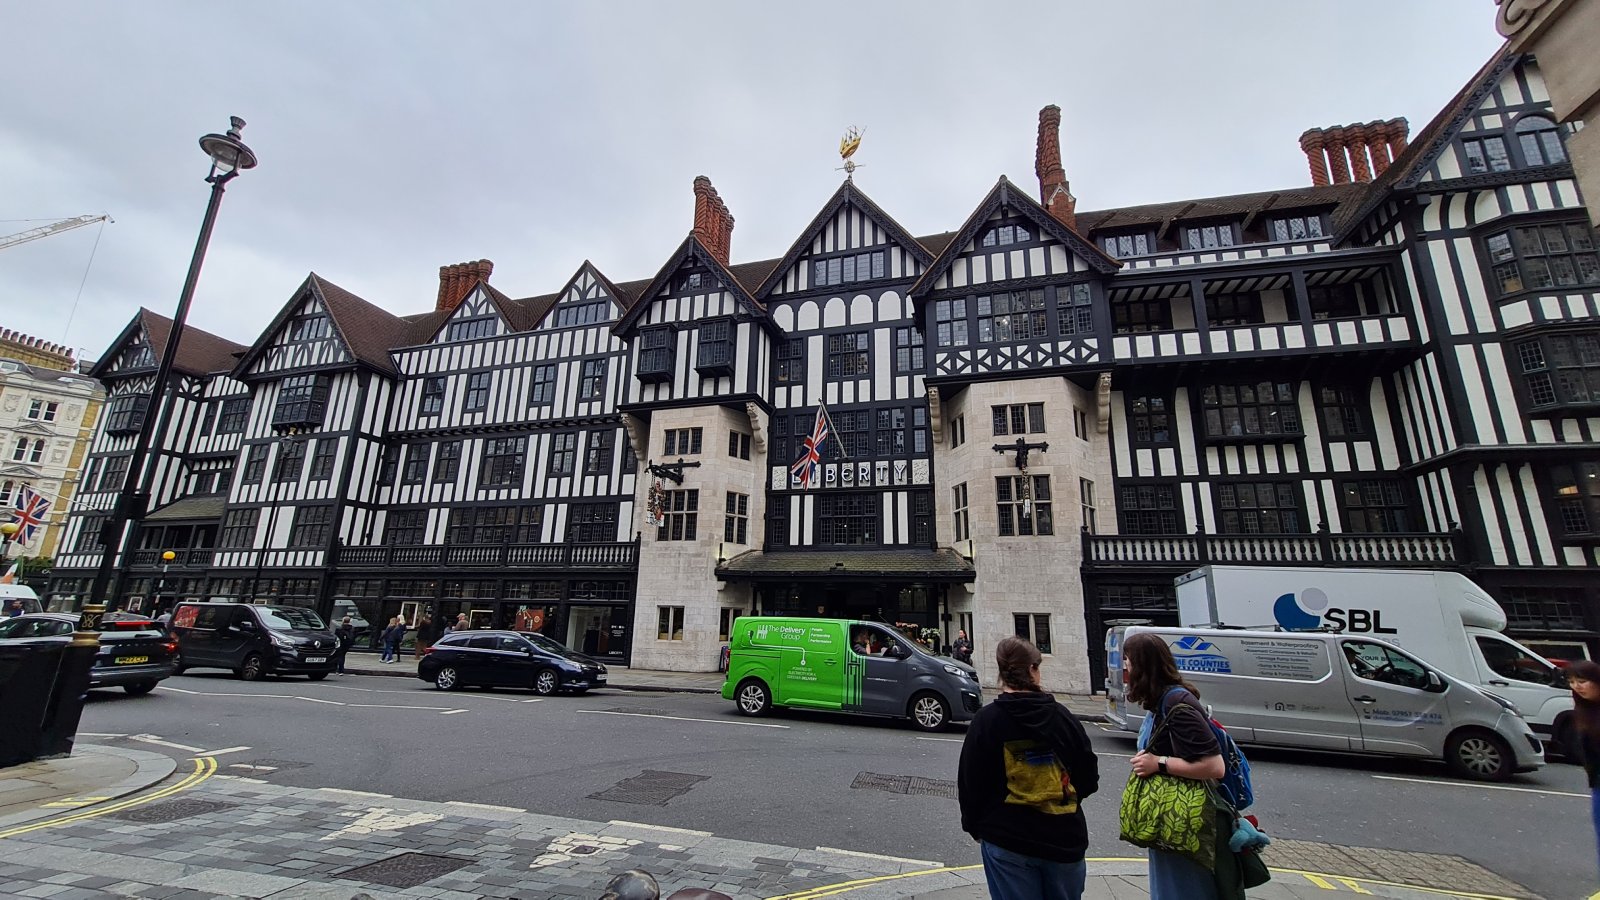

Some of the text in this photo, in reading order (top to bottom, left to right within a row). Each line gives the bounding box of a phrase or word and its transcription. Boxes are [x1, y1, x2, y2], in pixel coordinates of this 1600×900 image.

[1323, 608, 1397, 634] SBL
[780, 626, 806, 635] Delivery
[1276, 641, 1319, 649] Waterproofing
[1188, 660, 1231, 669] COUNTIES
